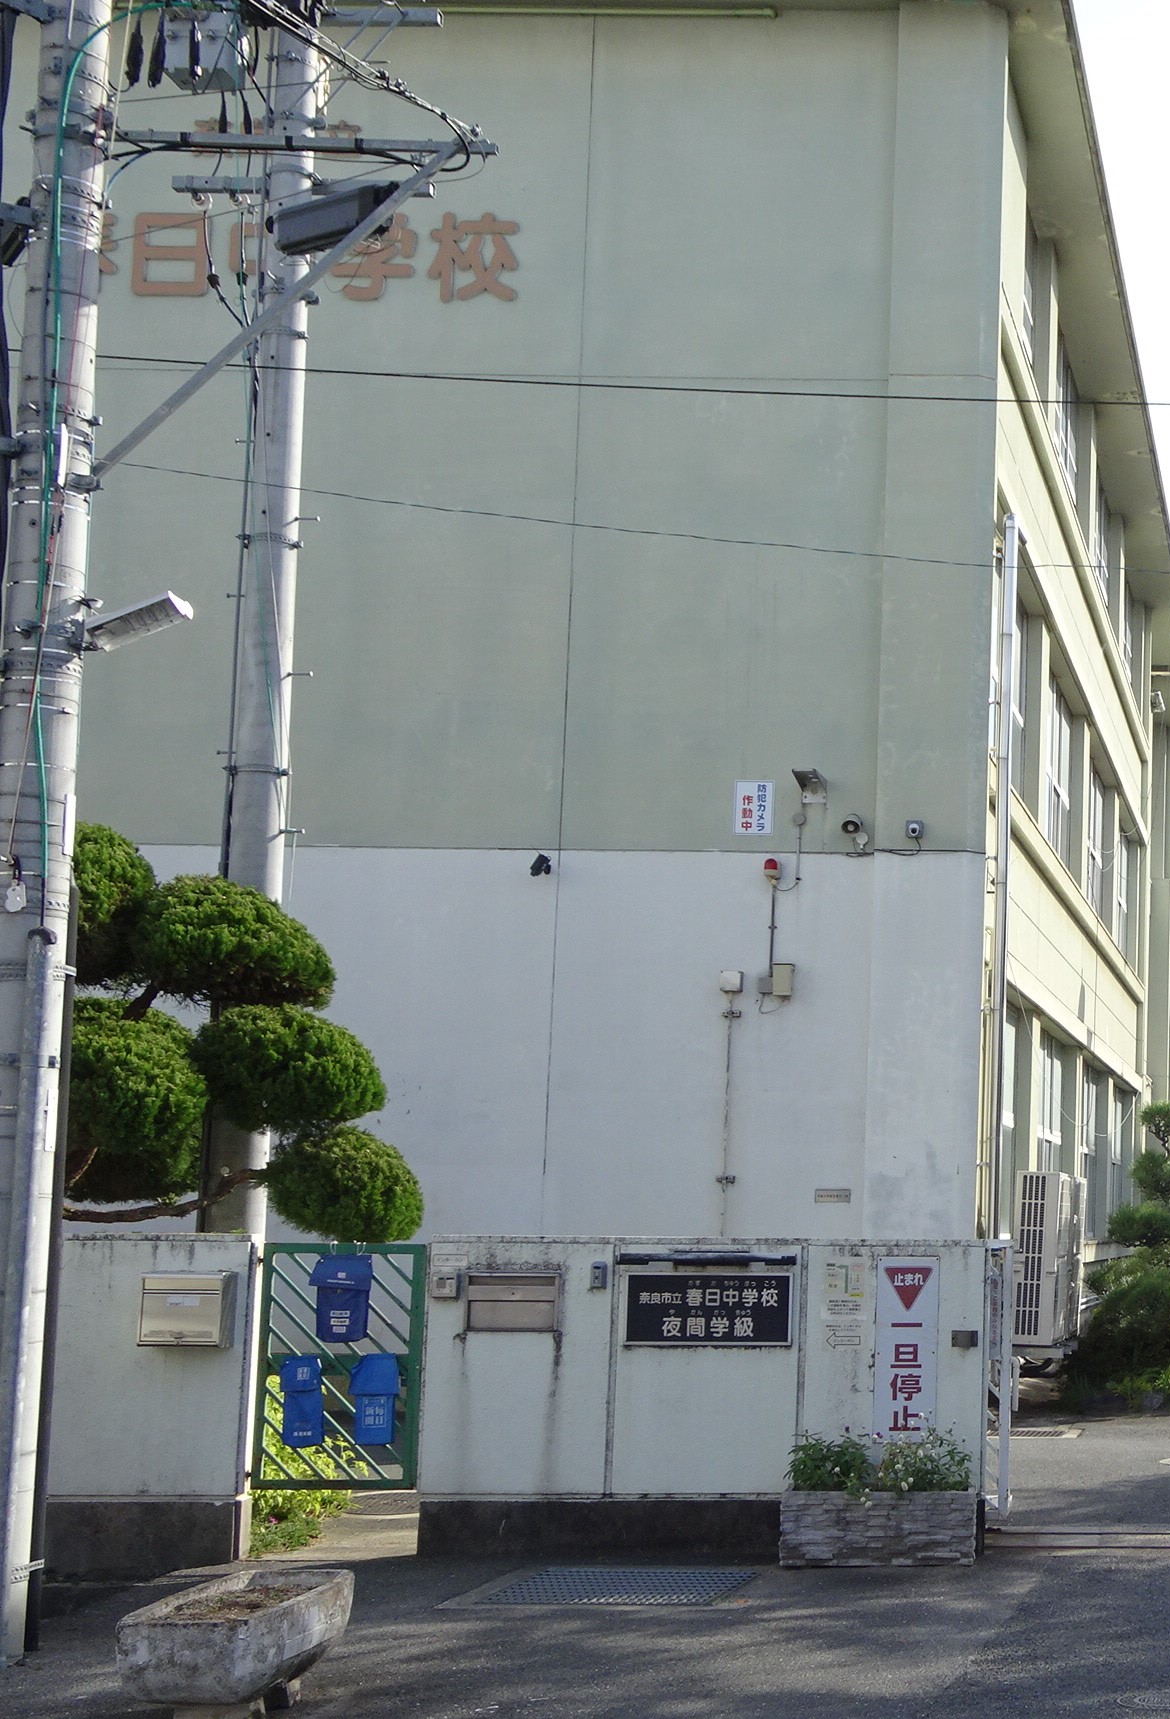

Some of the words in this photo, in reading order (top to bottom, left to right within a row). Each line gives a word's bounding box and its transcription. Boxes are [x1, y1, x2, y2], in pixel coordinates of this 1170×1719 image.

[741, 794, 754, 832] 作動中
[756, 783, 767, 832] 防犯カメラ
[893, 1272, 924, 1287] 止まれ
[639, 1291, 682, 1305] 奈良市立
[685, 1288, 779, 1307] 春日中学校
[661, 1315, 754, 1338] 夜間学級
[888, 1322, 923, 1432] 一旦停止
